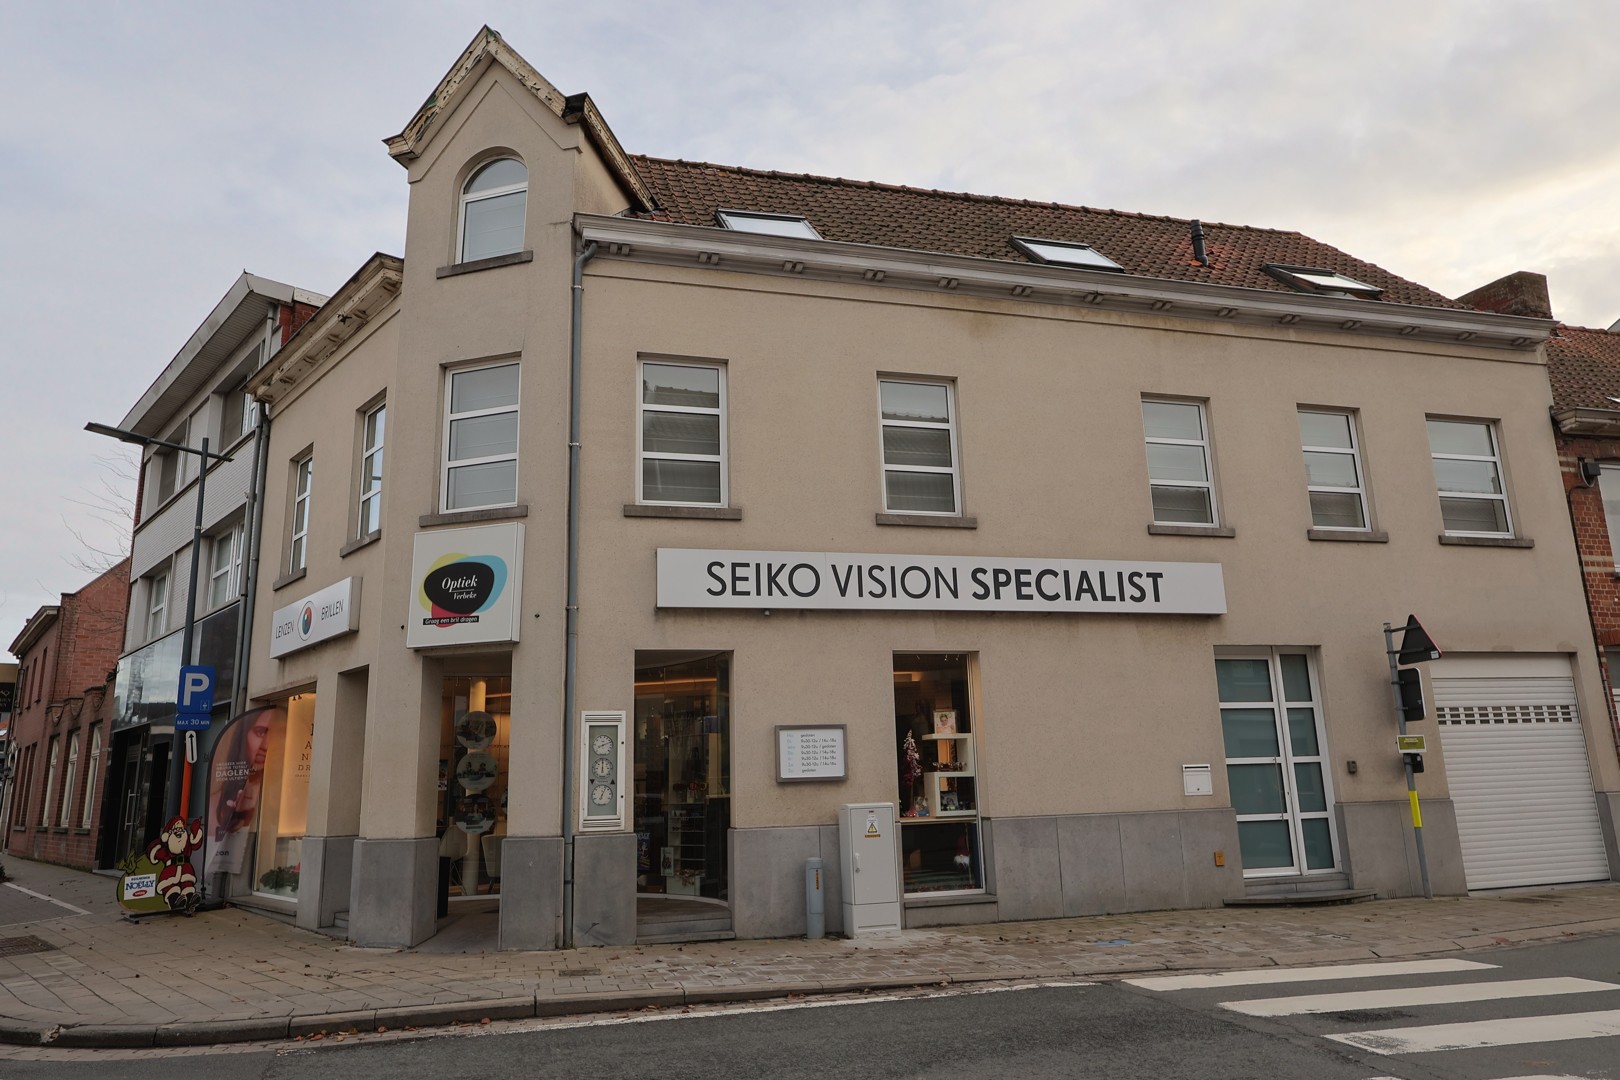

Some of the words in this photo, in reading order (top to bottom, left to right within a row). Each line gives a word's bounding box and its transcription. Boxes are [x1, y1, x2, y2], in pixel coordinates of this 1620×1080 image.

[441, 575, 478, 593] Optiek
[453, 592, 477, 600] Verbeke
[706, 561, 821, 598] SEIKO
[831, 564, 960, 599] VISION
[971, 567, 1163, 603] SPECIALIST
[275, 620, 295, 640] LENZEN
[321, 599, 344, 621] BRILLEN
[183, 673, 210, 706] P
